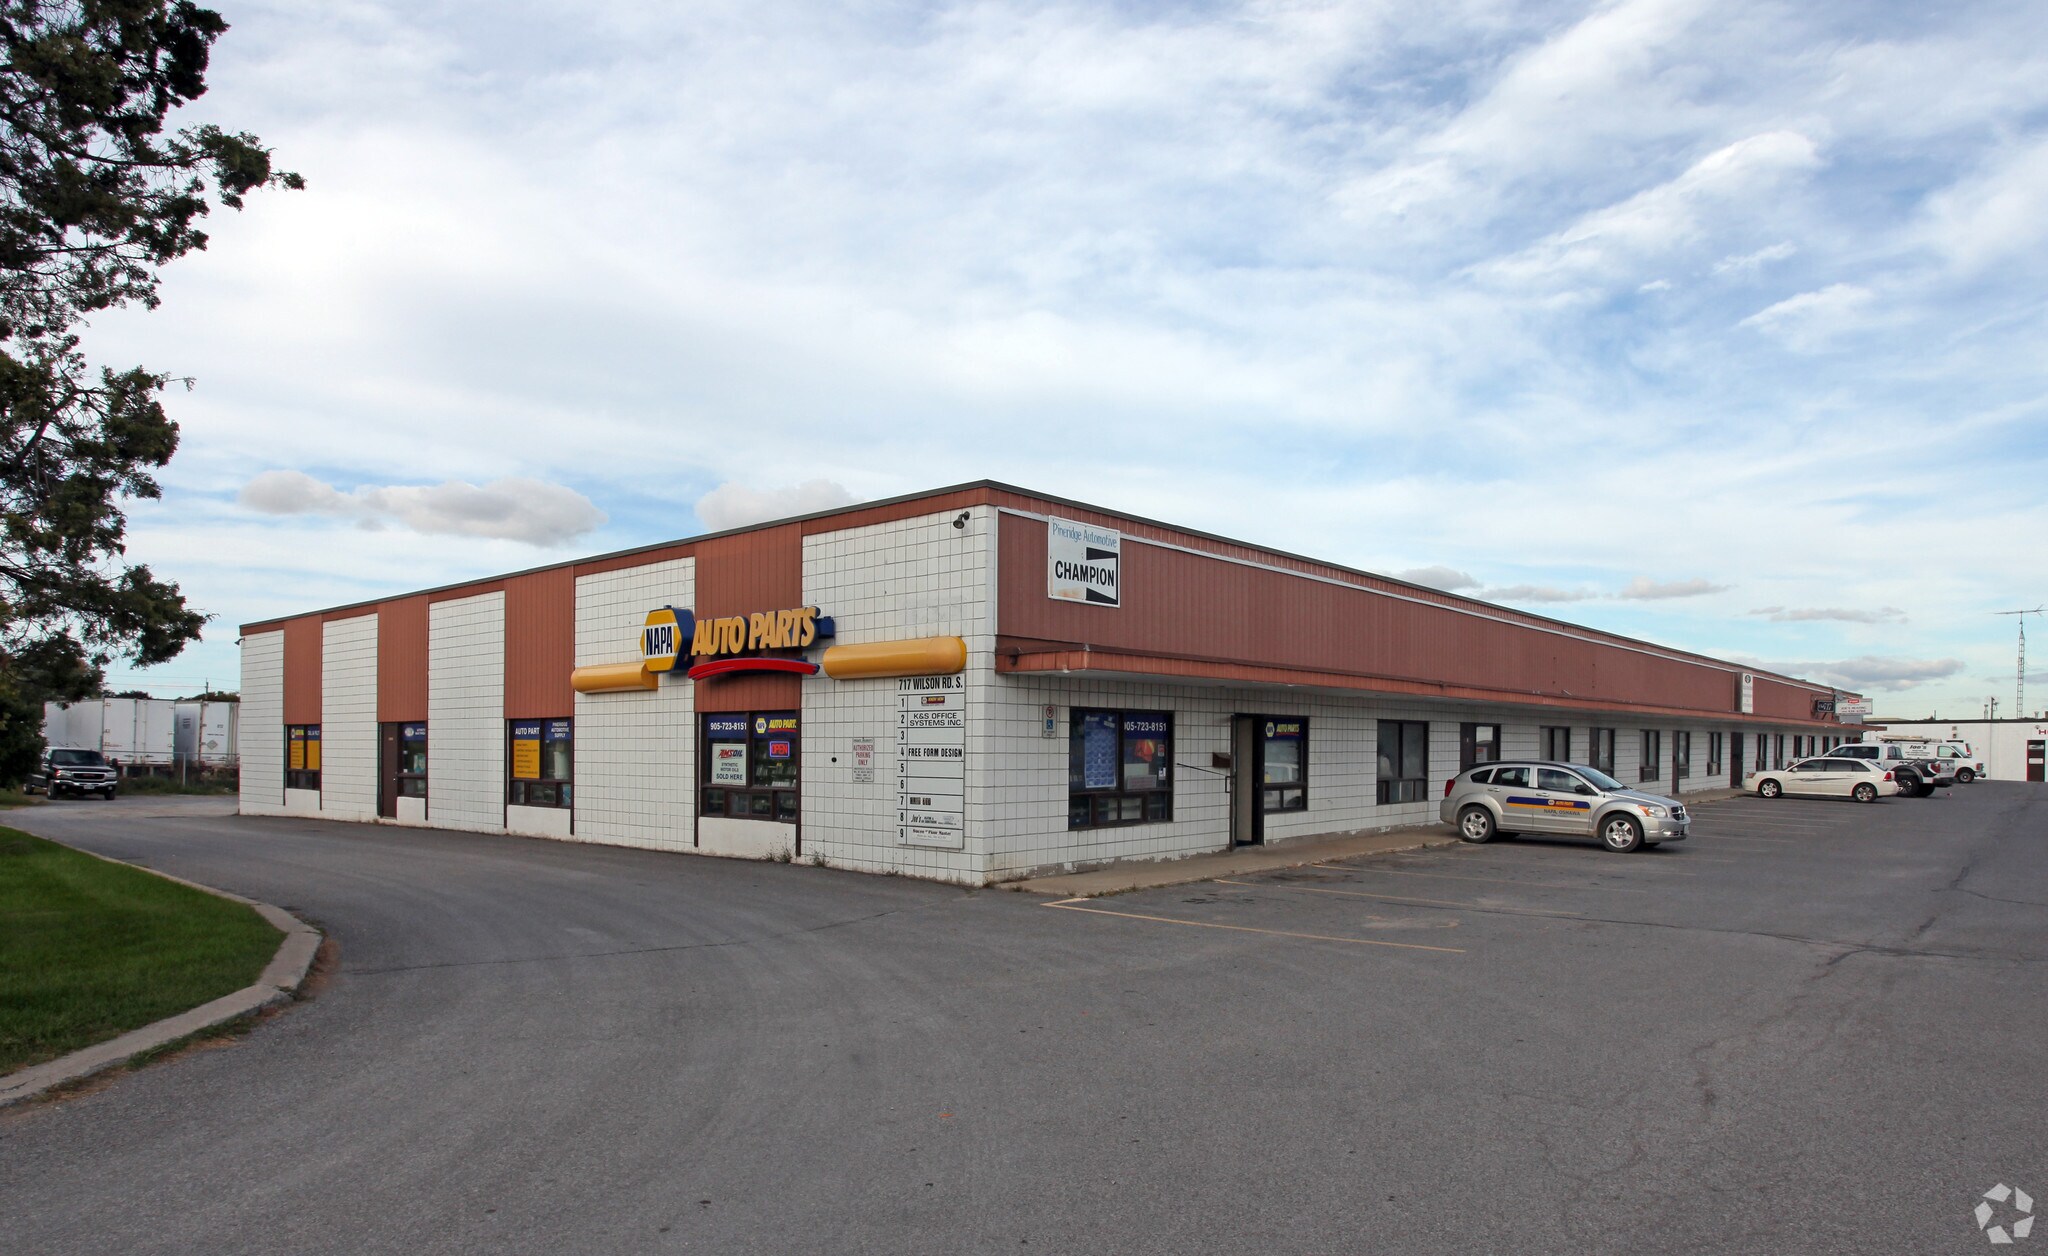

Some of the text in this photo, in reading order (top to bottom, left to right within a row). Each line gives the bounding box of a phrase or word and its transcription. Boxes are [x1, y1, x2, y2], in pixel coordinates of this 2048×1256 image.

[1052, 522, 1118, 548] Pineridge Automotive
[1055, 560, 1115, 587] CHAMPION
[691, 606, 818, 656] AUTO PARTS
[645, 625, 674, 656] NAPA
[899, 676, 963, 691] 717 WILSON RD. S.
[901, 698, 905, 708] 1
[900, 714, 905, 724] 2
[913, 712, 957, 720] K&S OFFICE
[710, 722, 747, 730] 905-723-8151
[768, 719, 783, 729] AUTO
[909, 719, 946, 727] SYSTEMS
[515, 727, 528, 735] AUTO
[900, 730, 905, 740] 3
[719, 749, 743, 758] AMSOIL
[771, 743, 788, 755] OPEN
[900, 746, 905, 757] 4
[908, 747, 963, 758] FREE FORM DESIGN
[900, 763, 905, 773] 5
[900, 779, 905, 789] 6
[900, 795, 904, 805] 7
[900, 812, 904, 822] 8
[900, 828, 904, 838] 9
